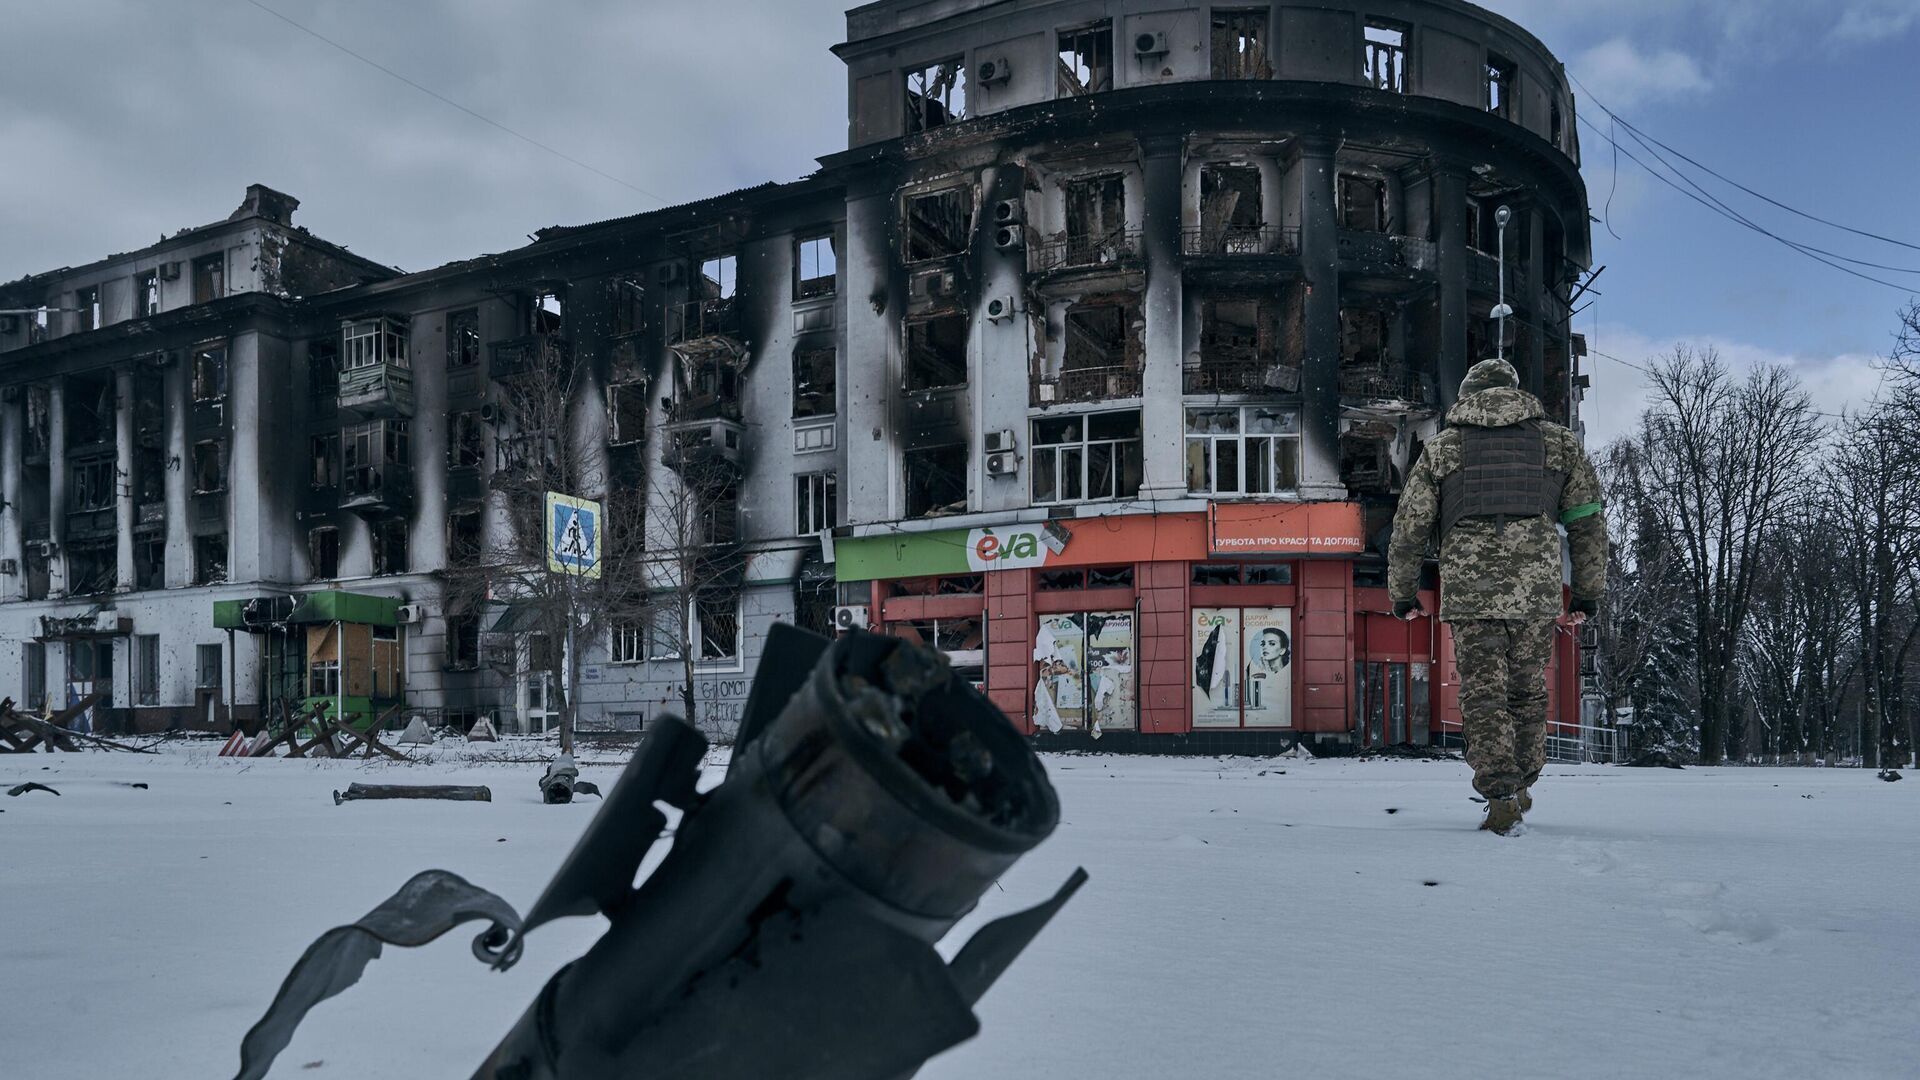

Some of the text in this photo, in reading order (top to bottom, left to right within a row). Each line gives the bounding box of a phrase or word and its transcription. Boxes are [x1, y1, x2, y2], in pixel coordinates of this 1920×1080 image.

[1257, 537, 1278, 546] ПРО
[1279, 537, 1308, 546] КРАСУ
[1310, 537, 1322, 546] ТА
[1323, 537, 1360, 546] ДОГЛЯД
